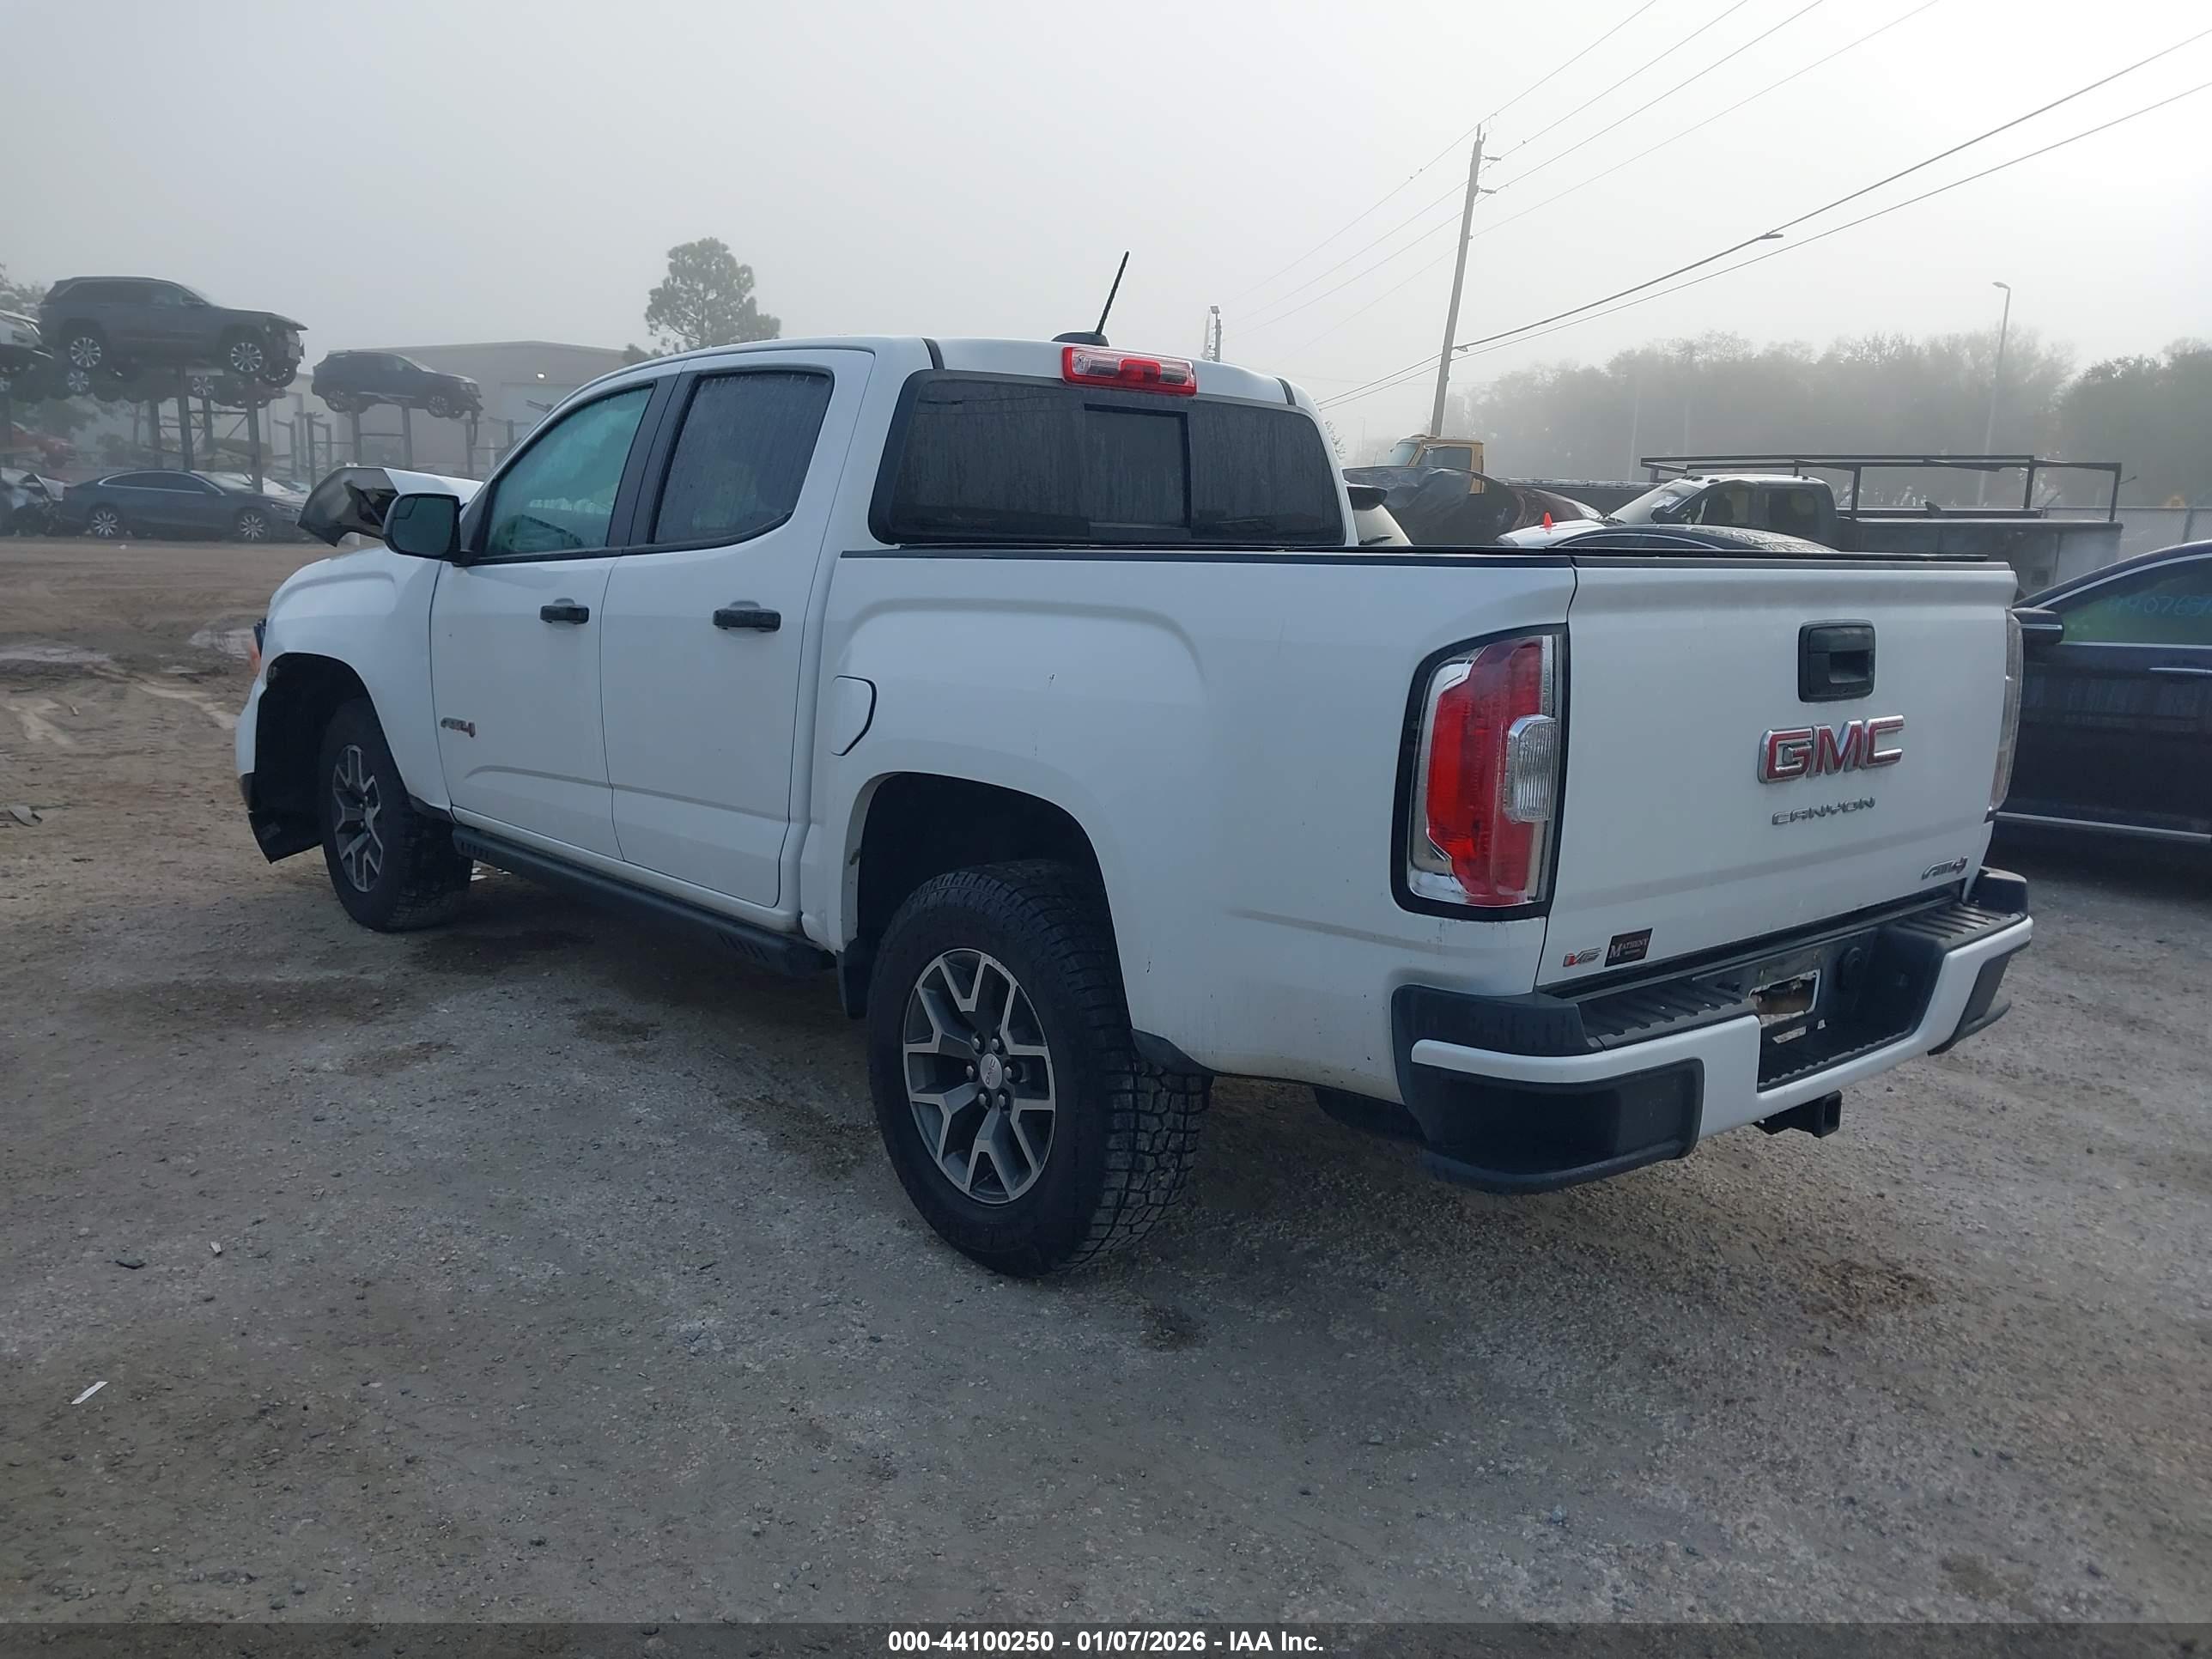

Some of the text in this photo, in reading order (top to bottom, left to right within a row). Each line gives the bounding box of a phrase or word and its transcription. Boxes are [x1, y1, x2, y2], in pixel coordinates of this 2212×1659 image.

[1758, 714, 1905, 783] GMC
[1771, 797, 1876, 825] CANYON
[1563, 947, 1602, 968] V6
